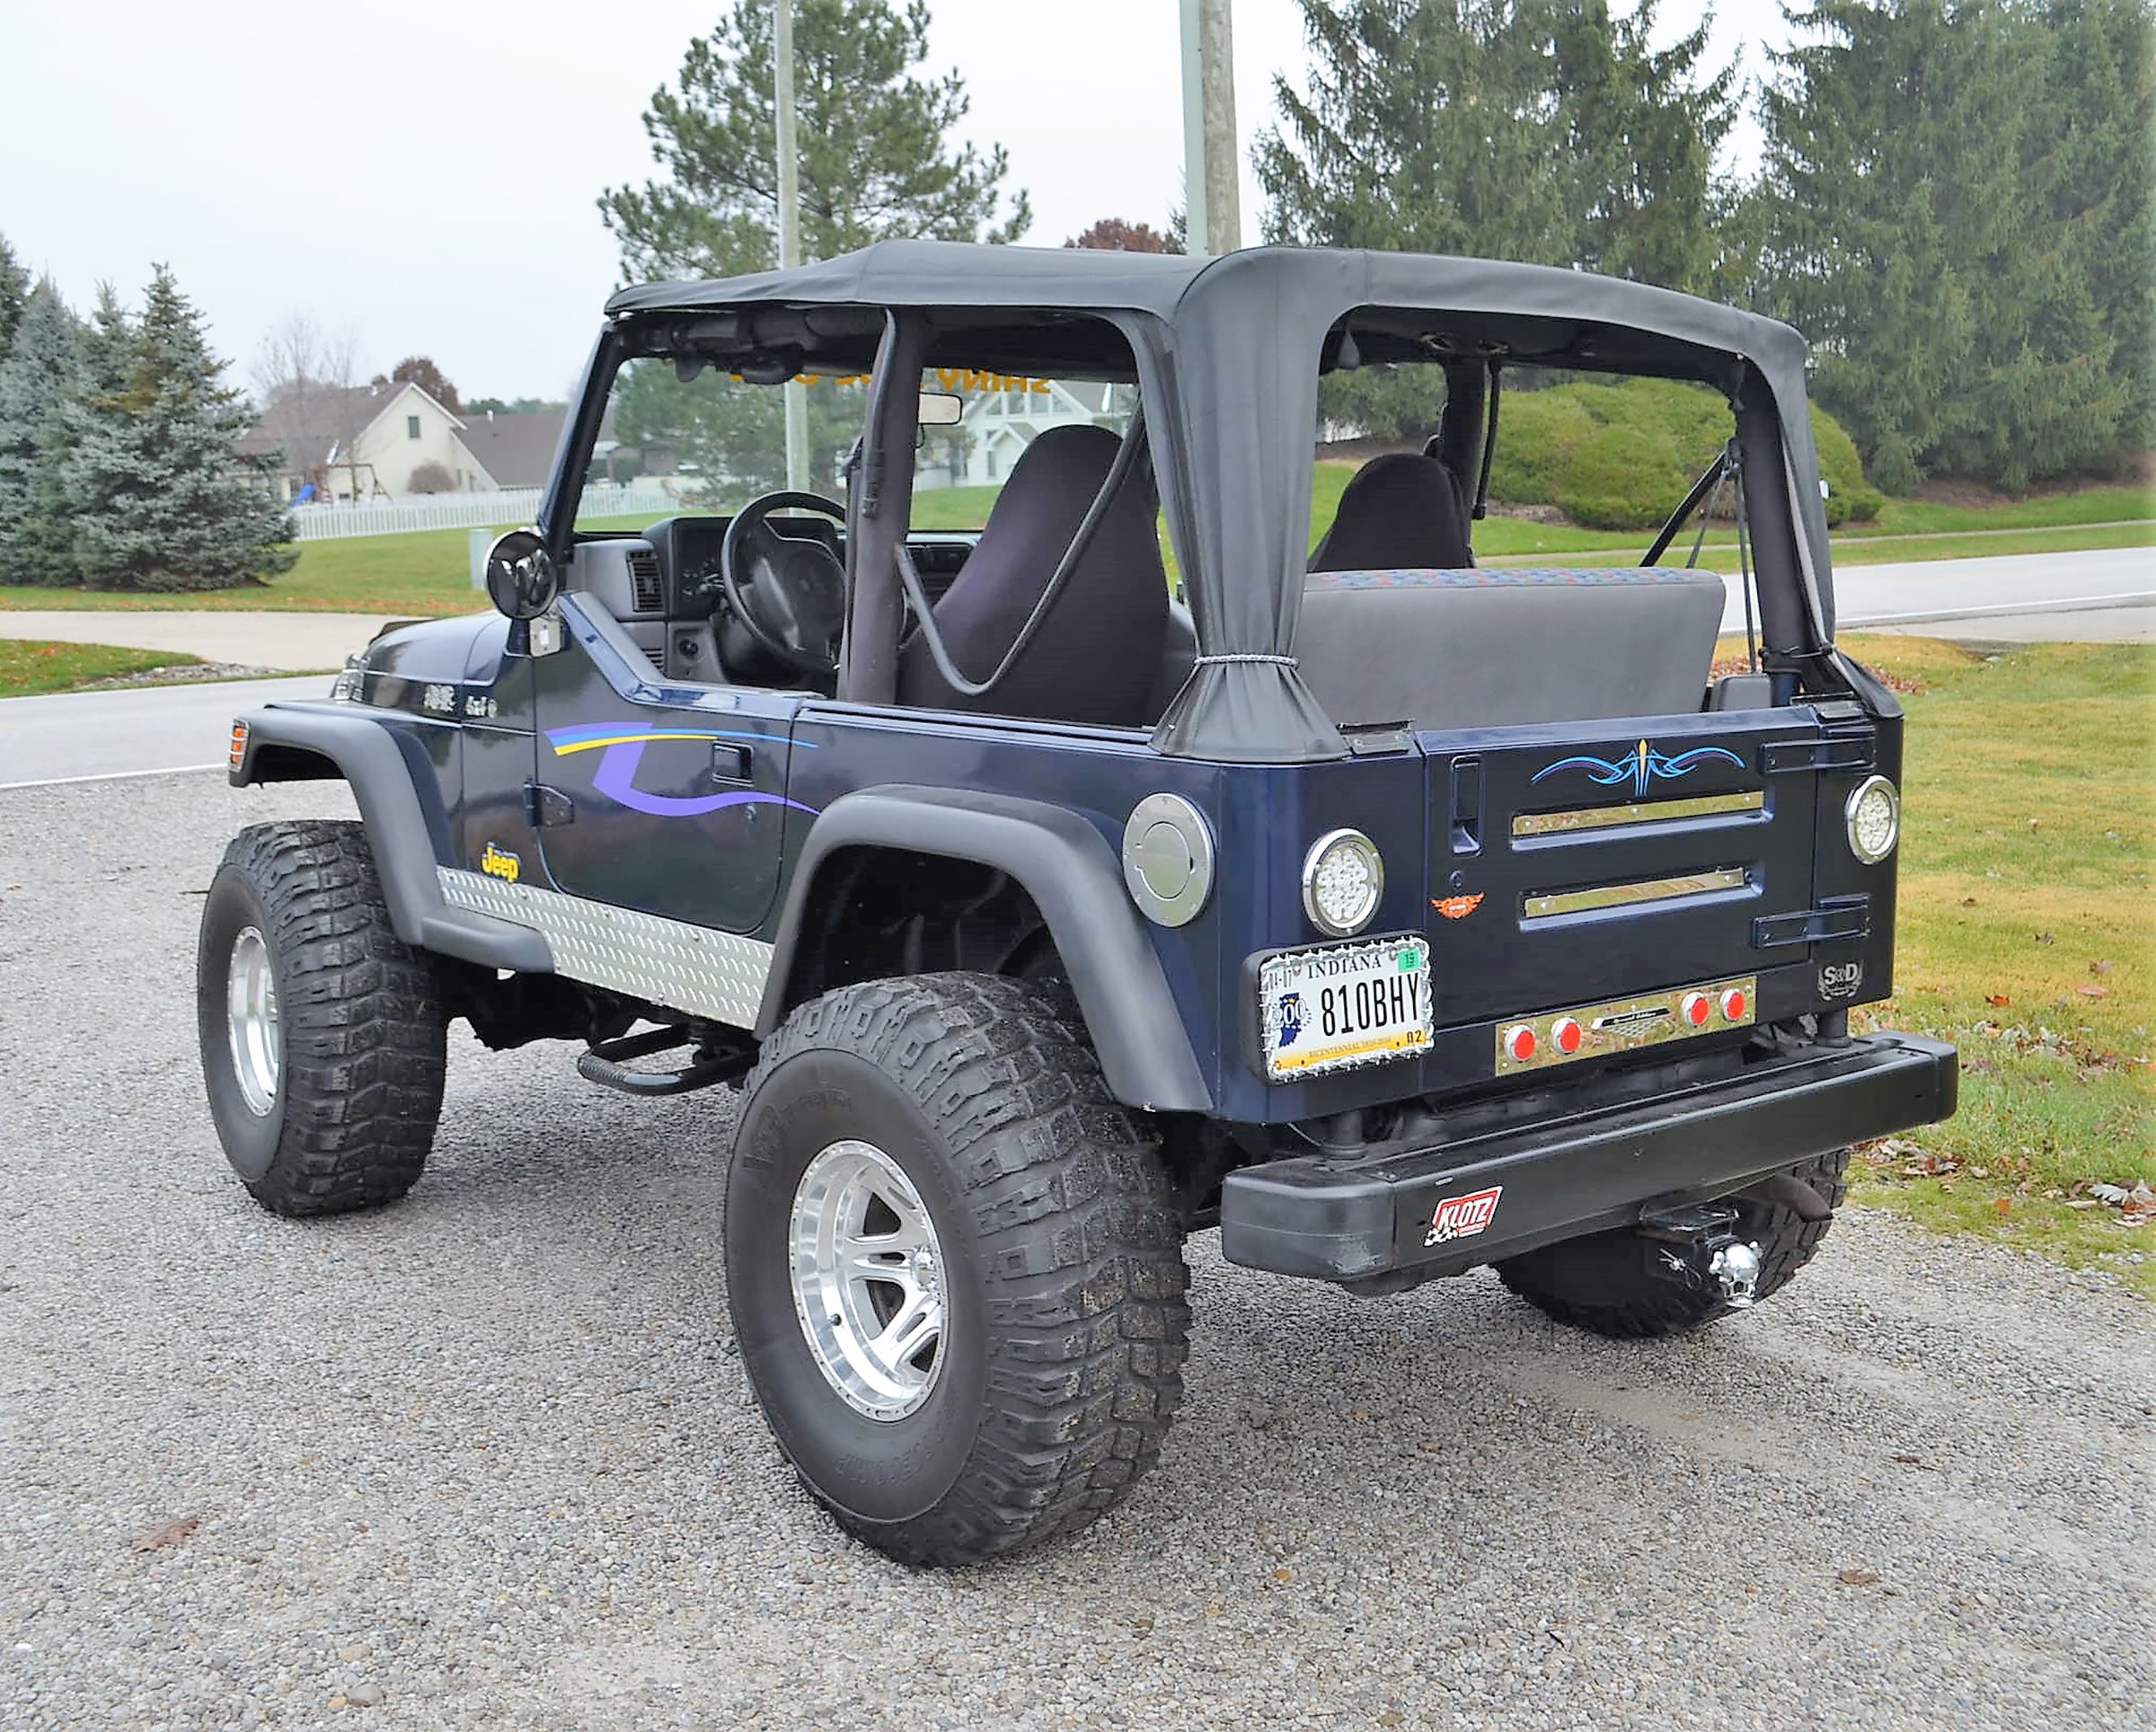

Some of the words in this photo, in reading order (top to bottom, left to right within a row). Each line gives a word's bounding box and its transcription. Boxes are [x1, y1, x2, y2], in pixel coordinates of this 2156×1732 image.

[482, 842, 520, 883] Jeep
[1308, 954, 1382, 978] INDIANA
[1824, 963, 1859, 985] S&D
[1321, 973, 1418, 1037] 810BHY
[1407, 1029, 1422, 1043] 02
[1437, 1197, 1493, 1230] KLOTZ
